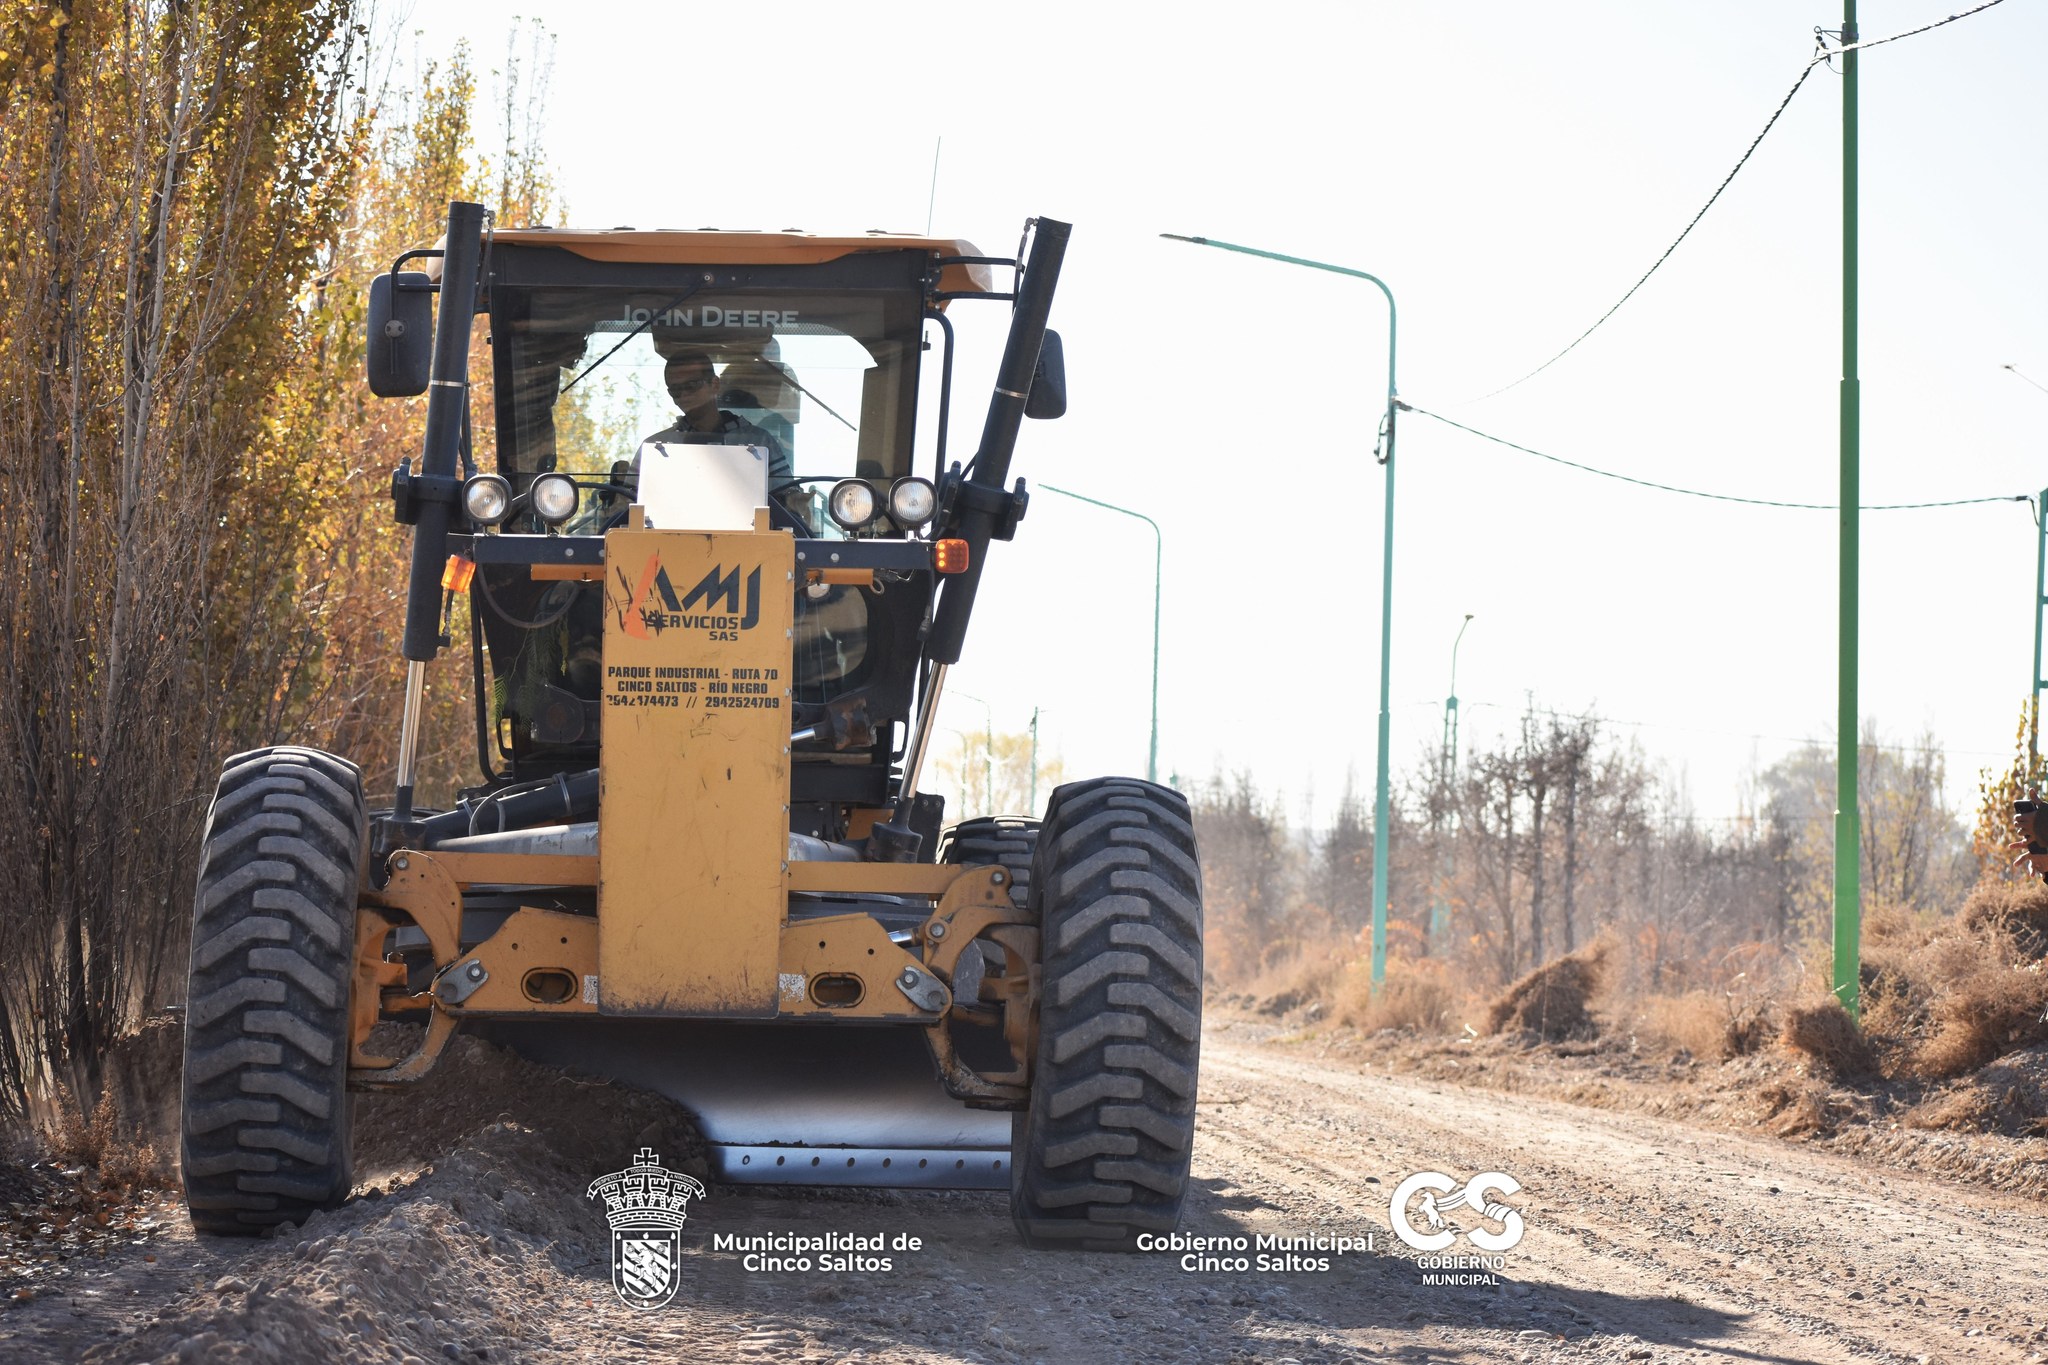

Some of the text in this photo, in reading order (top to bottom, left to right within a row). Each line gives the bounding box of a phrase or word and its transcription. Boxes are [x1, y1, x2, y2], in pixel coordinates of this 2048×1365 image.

[614, 304, 800, 328] JOHN DEERE
[646, 613, 738, 630] SERVICIOS
[709, 631, 738, 641] SAS
[608, 666, 651, 679] PARQUE
[655, 667, 720, 679] INDUSTRIAL
[732, 668, 760, 679] RUTA
[764, 669, 778, 680] 70
[617, 681, 652, 692] CINCO
[656, 681, 697, 693] SALTOS
[709, 680, 728, 694] RÍO
[732, 683, 768, 694] NEGRO
[705, 696, 779, 708] 2942524709
